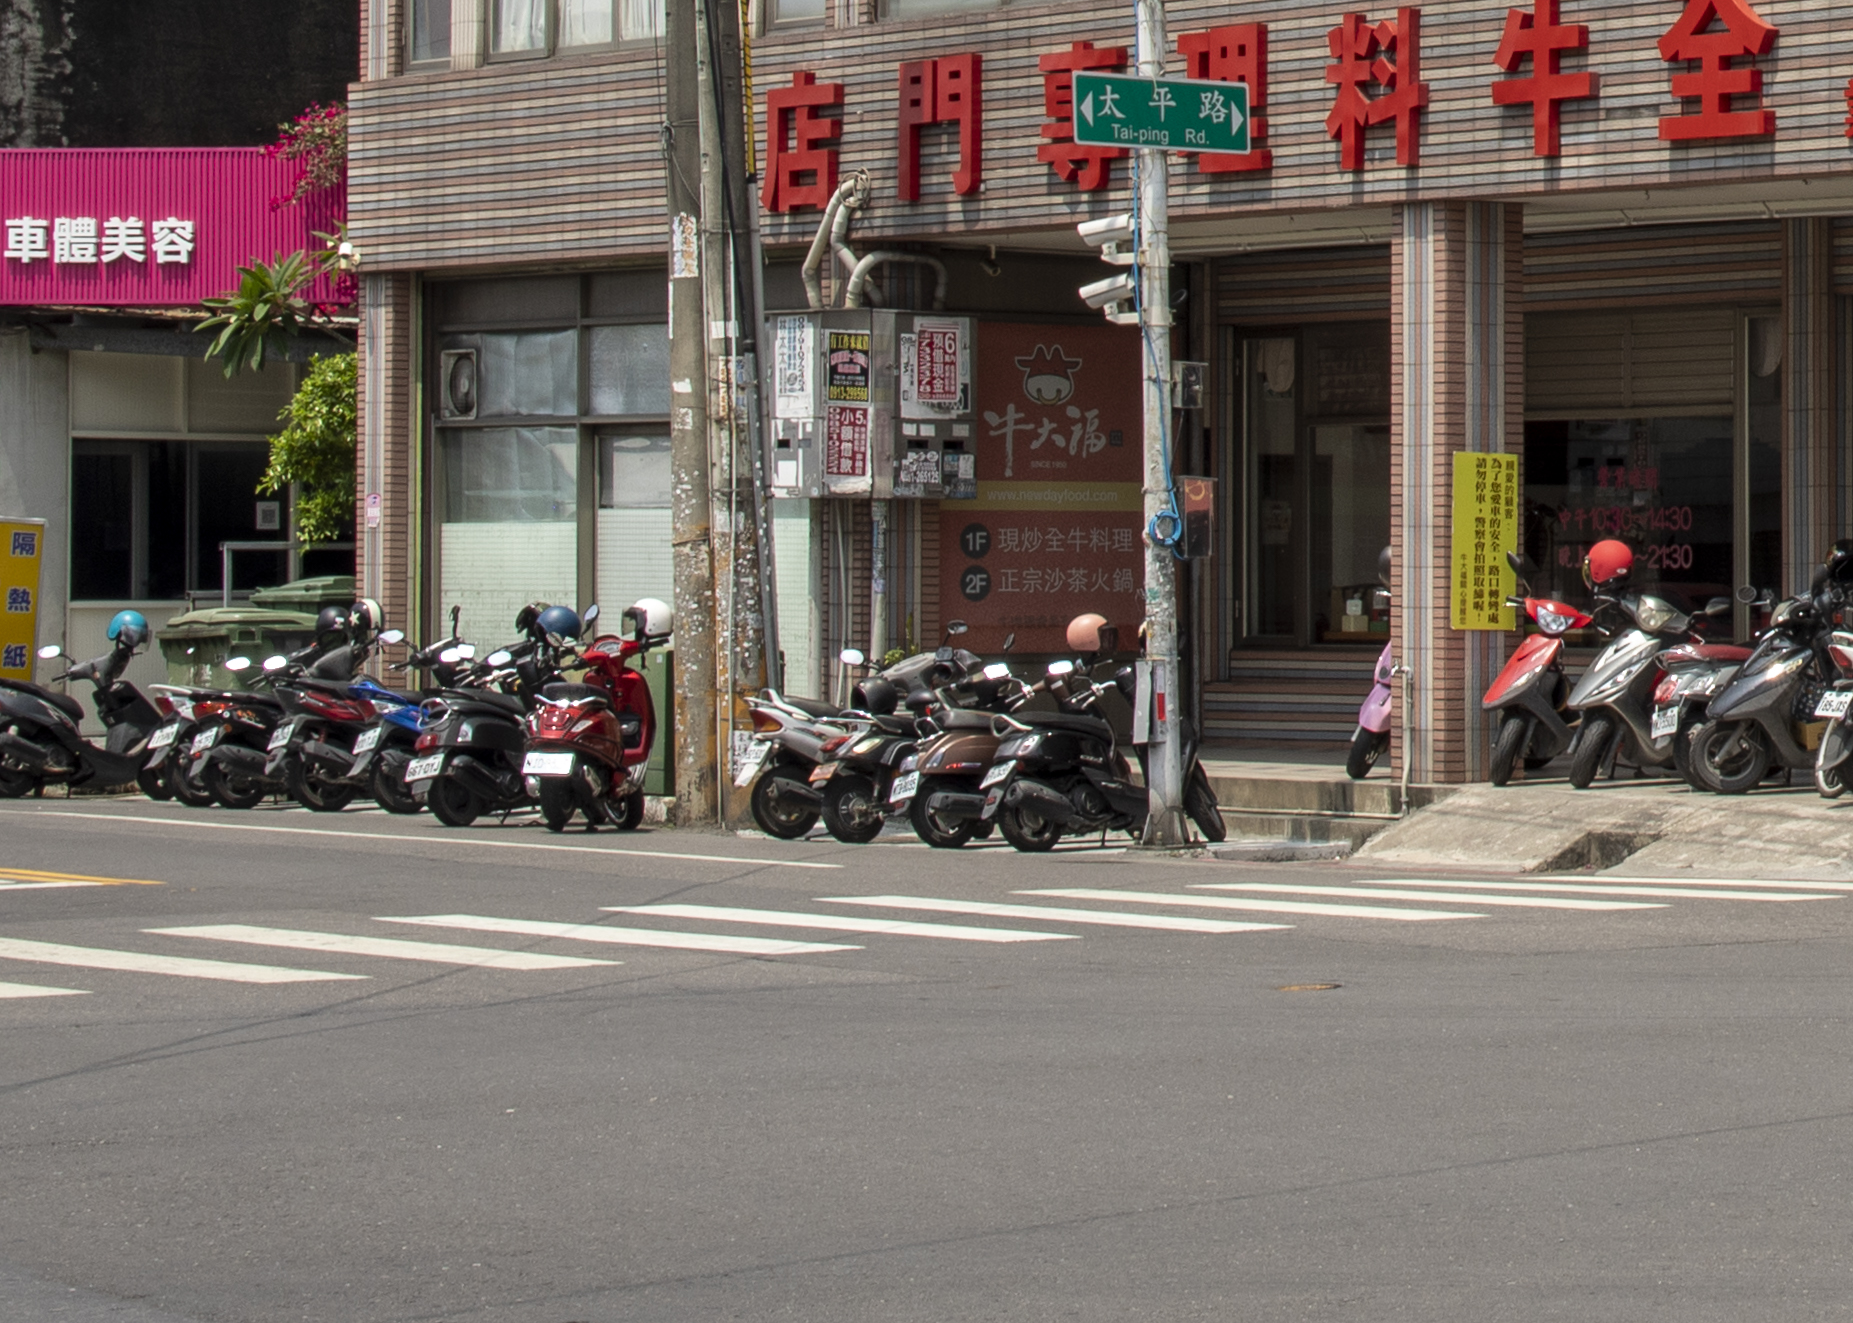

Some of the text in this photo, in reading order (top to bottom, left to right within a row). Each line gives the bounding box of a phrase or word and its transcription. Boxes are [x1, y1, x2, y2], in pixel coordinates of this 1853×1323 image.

[1097, 84, 1229, 124] 太平路
[1111, 123, 1210, 146] Tai-ping Rd.
[4, 215, 196, 265] 車體美容
[983, 403, 1107, 478] 牛大福
[986, 489, 1118, 504] www.newdayfood.com
[965, 526, 1135, 553] 1F 現炒全牛料理
[964, 567, 1135, 594] 2F 正宗沙茶火鍋
[3, 530, 38, 669] 隔熱紙
